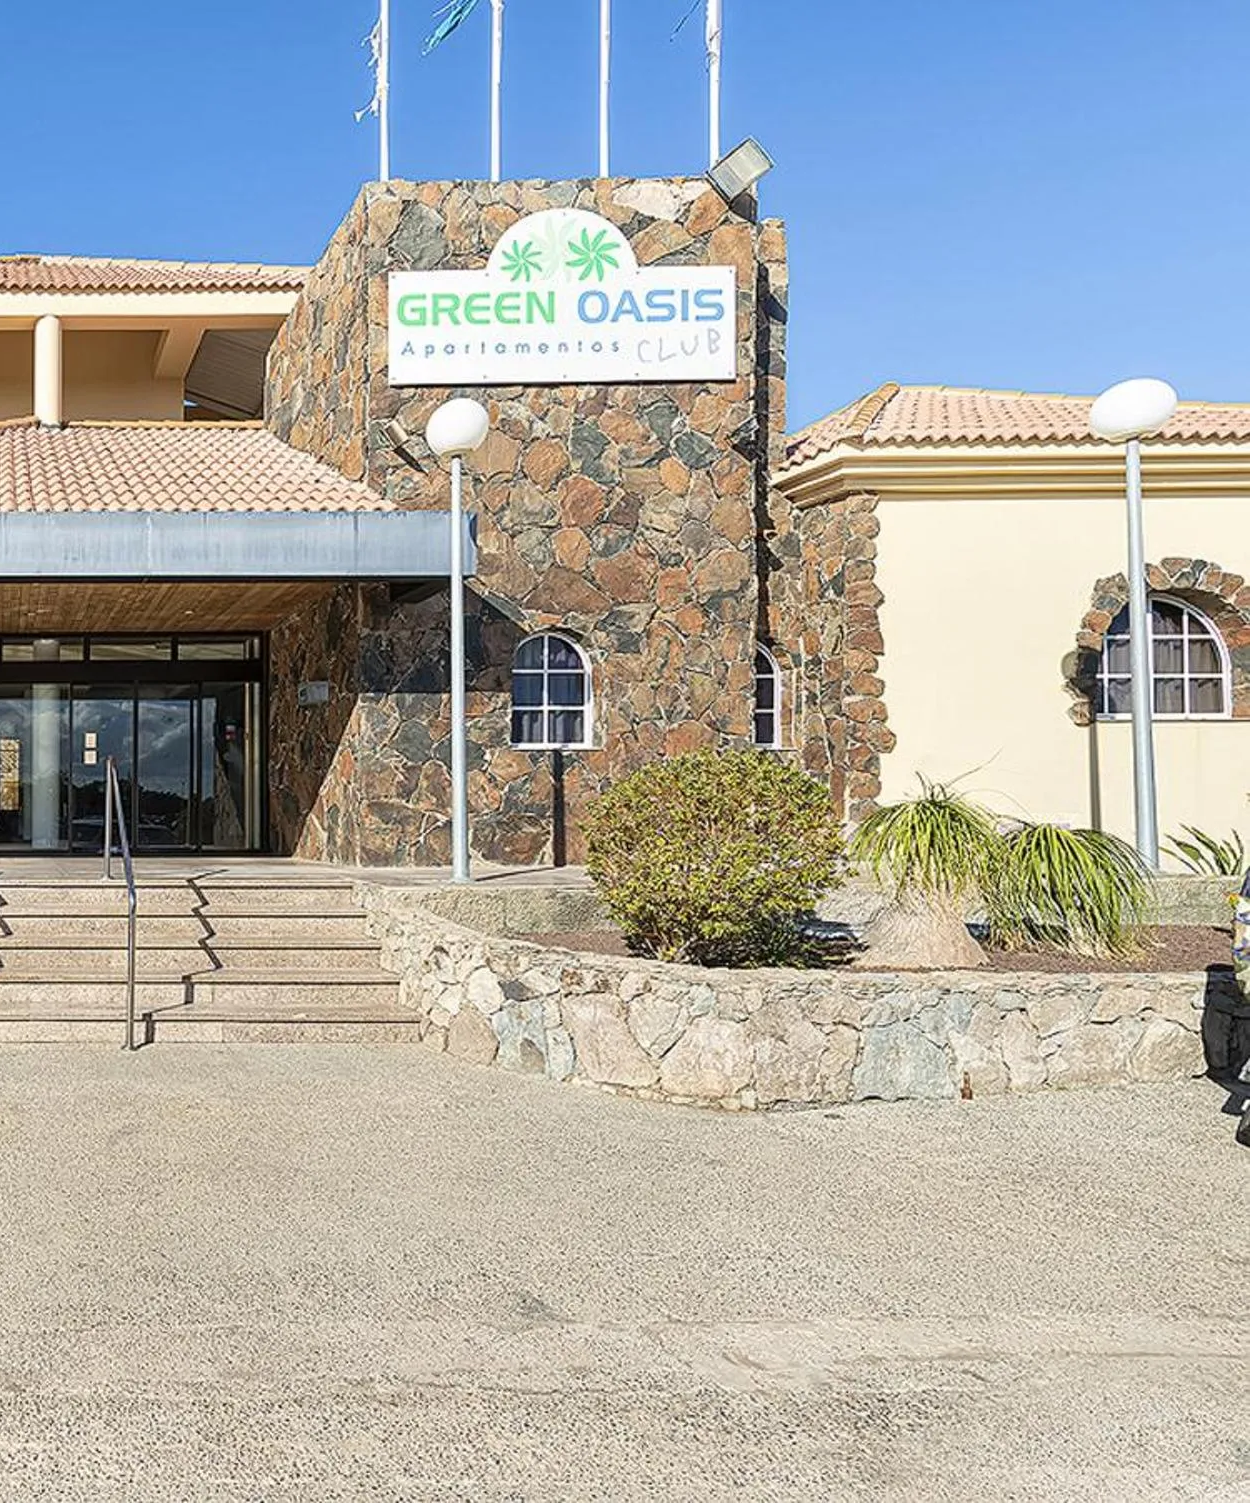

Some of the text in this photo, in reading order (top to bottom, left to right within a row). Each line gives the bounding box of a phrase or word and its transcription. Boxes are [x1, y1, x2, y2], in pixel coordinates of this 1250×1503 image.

[397, 289, 724, 325] GREEN OASIS
[400, 340, 621, 358] Apartamentos
[637, 328, 721, 363] CLUB
